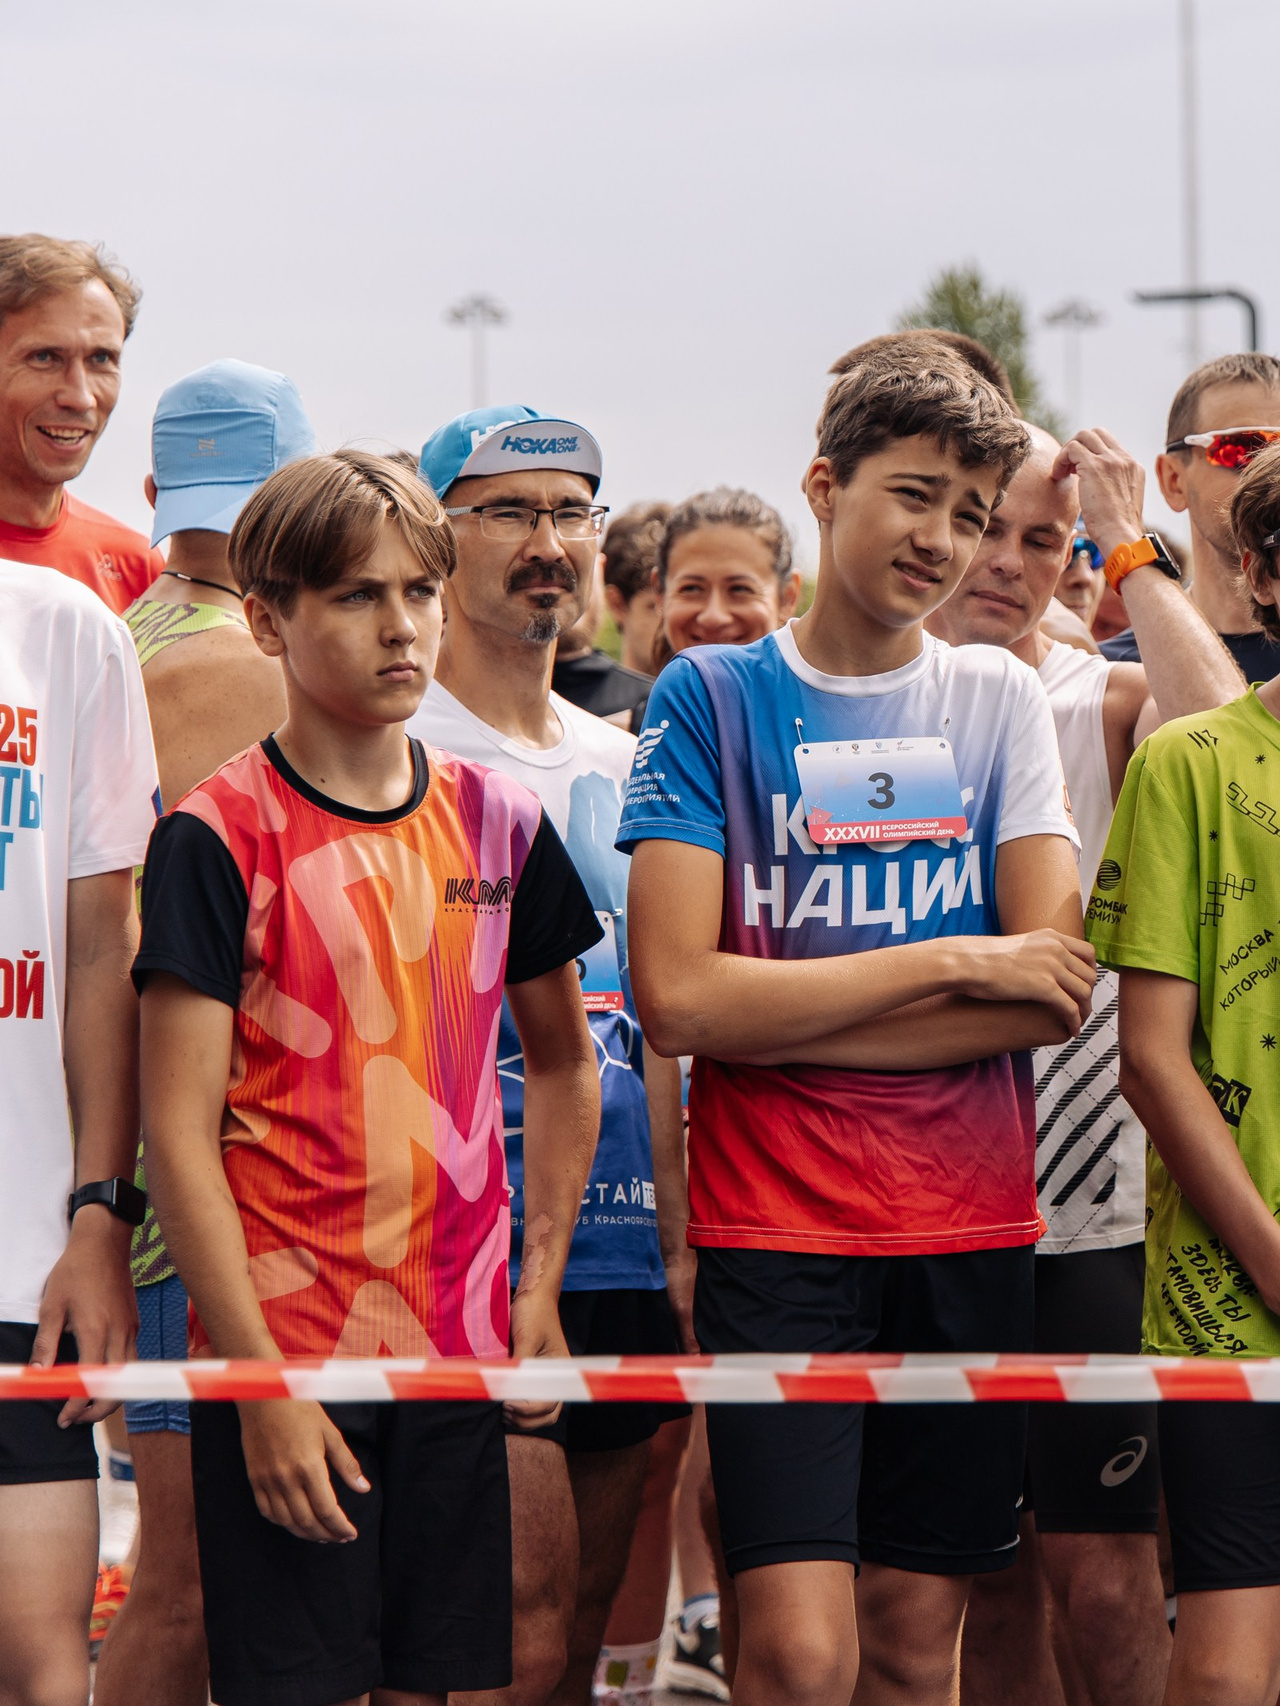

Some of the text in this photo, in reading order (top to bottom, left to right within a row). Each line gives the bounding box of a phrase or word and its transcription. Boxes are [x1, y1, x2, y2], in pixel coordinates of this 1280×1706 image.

[501, 435, 578, 454] HOKA ONE
[557, 444, 578, 454] ONE
[867, 772, 895, 809] 3
[823, 821, 939, 841] XXXVII ВСЕРОССИЙСКИЙ
[883, 828, 955, 838] ОЛИМПИЙСКИЙ ДЕНЬ
[743, 845, 984, 935] НАЦИИ
[1219, 928, 1275, 976] МОСКВА
[1181, 1243, 1252, 1322] ЗДЕСЬ ТЫ
